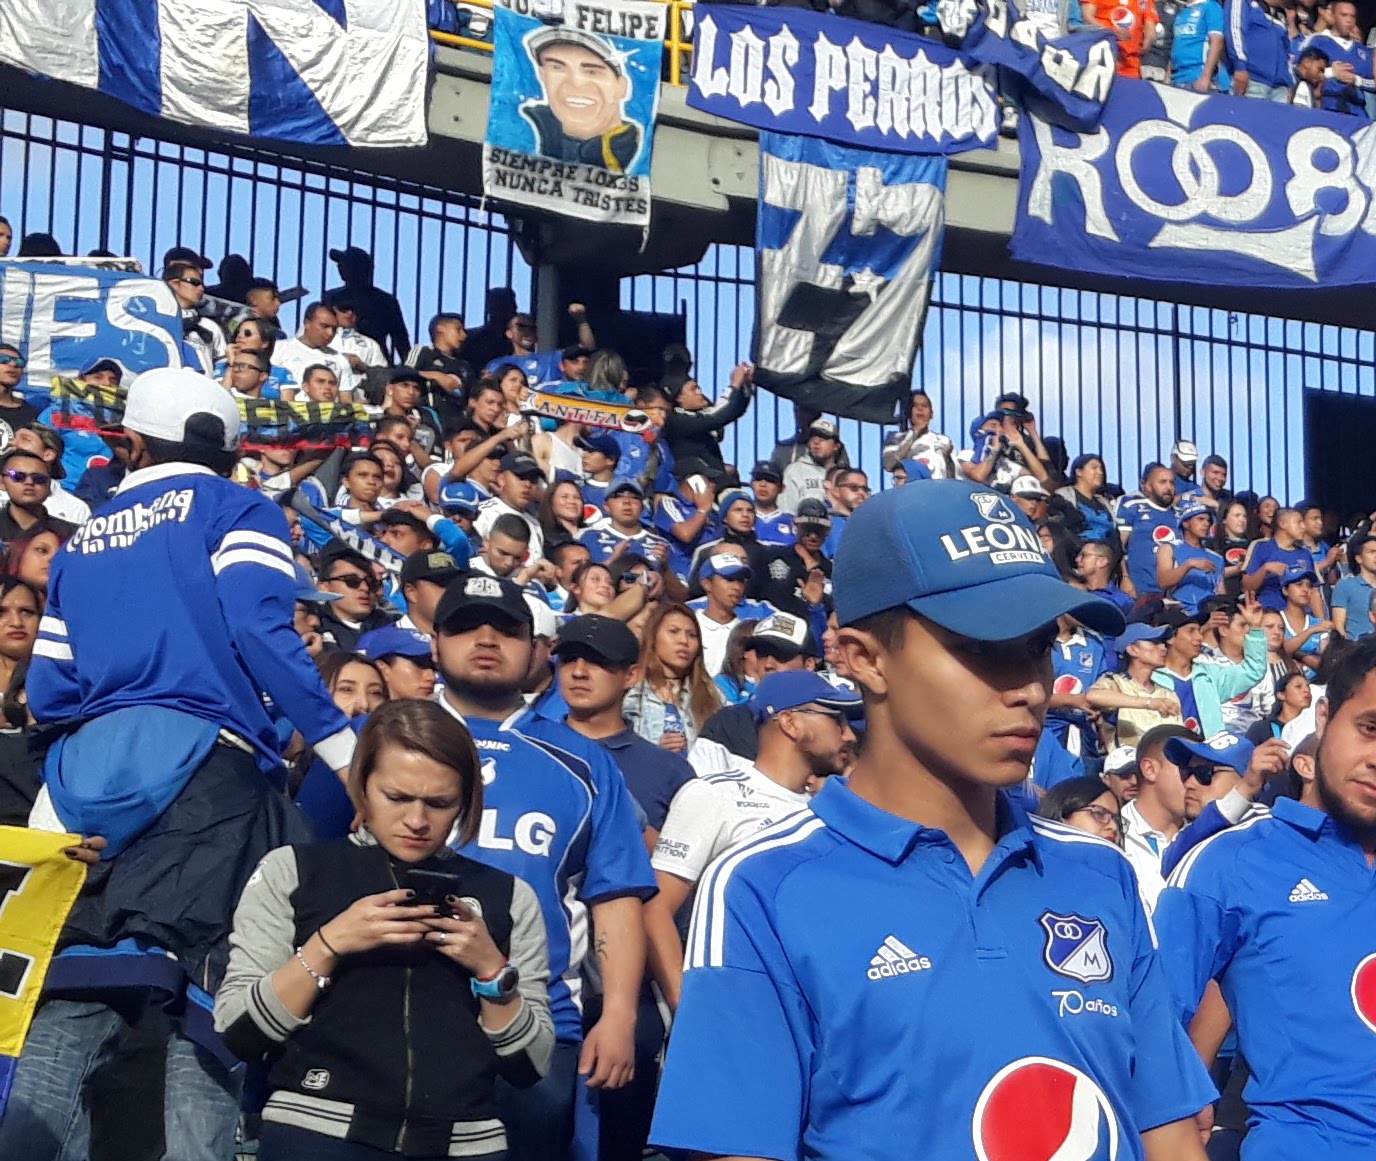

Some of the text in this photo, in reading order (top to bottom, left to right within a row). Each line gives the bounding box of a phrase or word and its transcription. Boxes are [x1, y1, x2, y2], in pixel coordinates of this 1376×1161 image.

[577, 4, 660, 39] FELIPE
[692, 14, 800, 117] LOS
[808, 31, 998, 143] PERROS
[488, 148, 578, 184] SIEMPRE
[494, 169, 649, 215] NUNCA TRISTES
[539, 401, 619, 425] ANTIFA
[477, 808, 557, 858] LG
[1289, 892, 1328, 902] adidas
[867, 955, 932, 982] adidas
[1051, 990, 1119, 1018] 70 años
